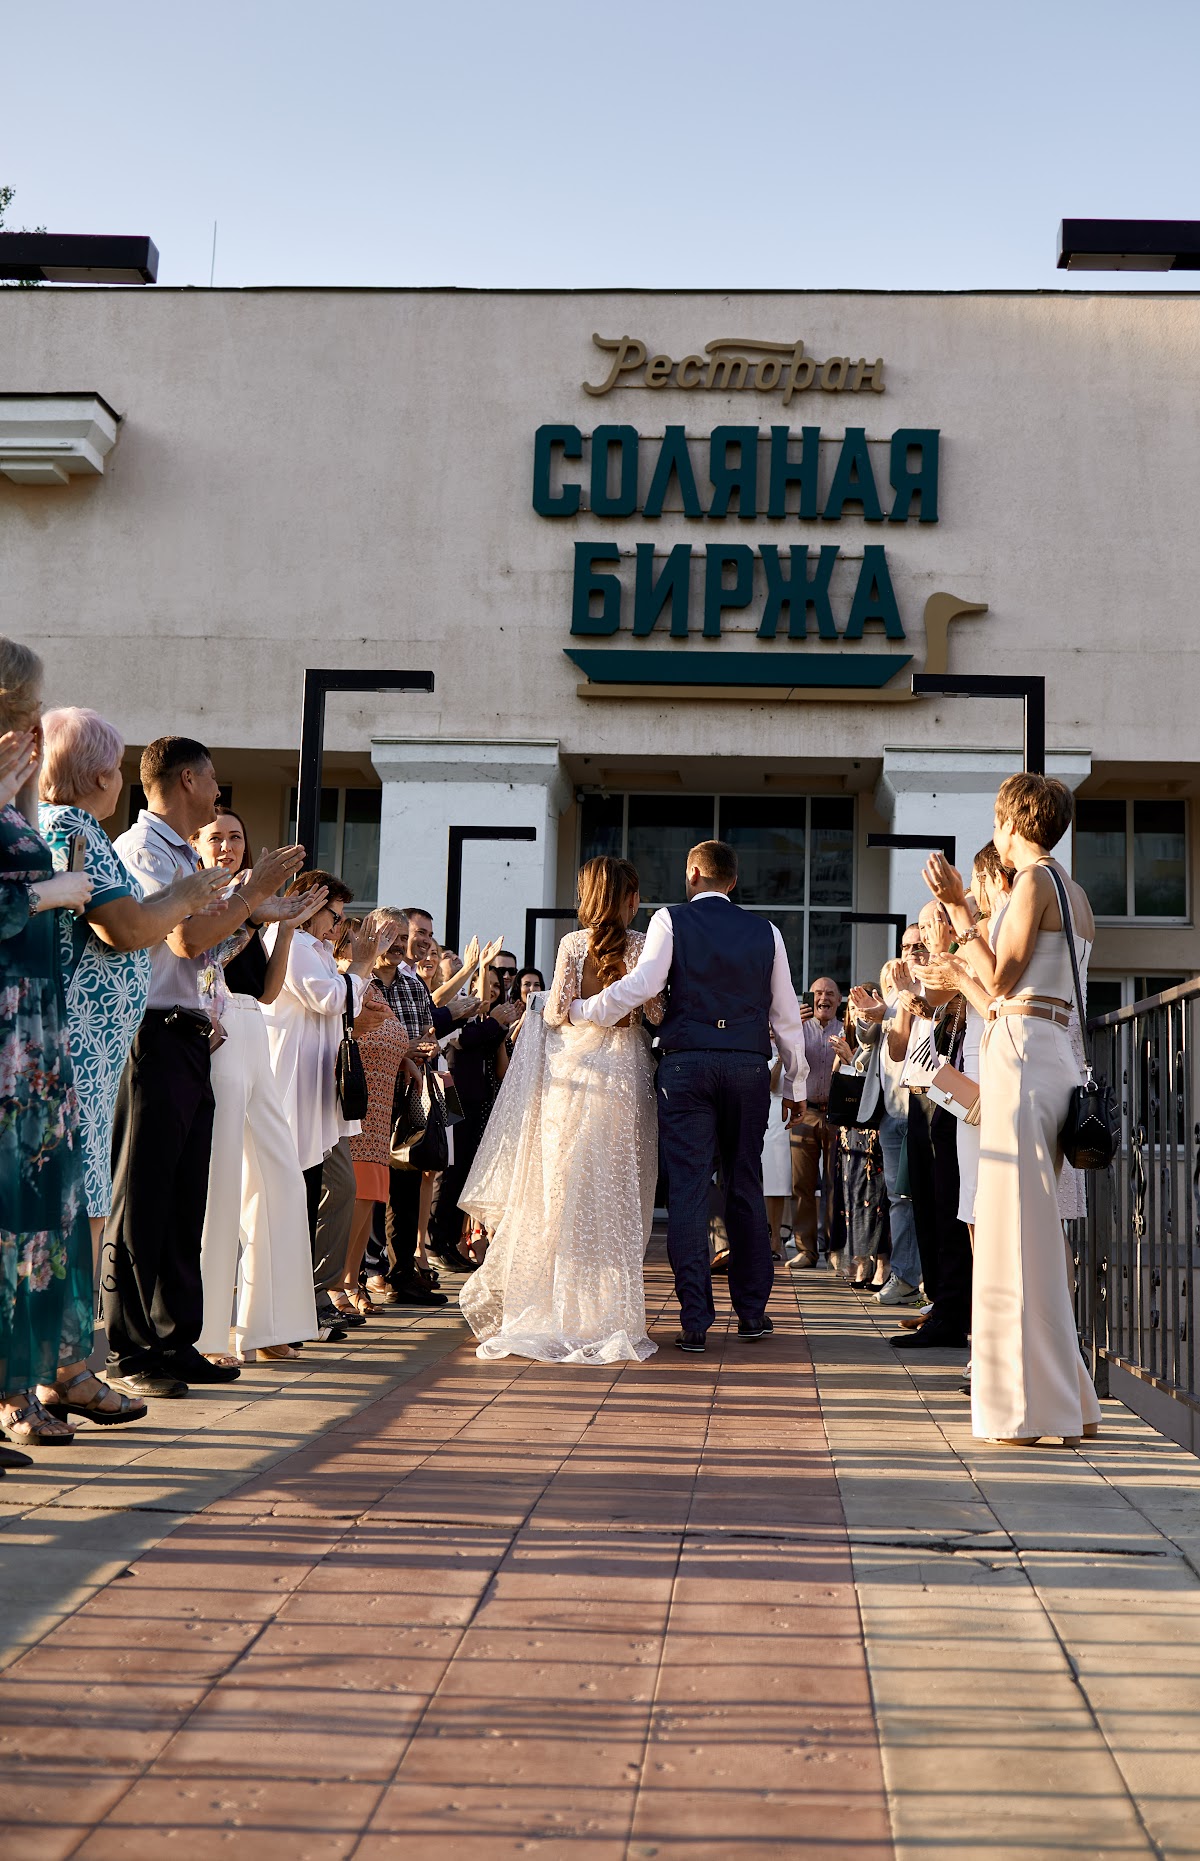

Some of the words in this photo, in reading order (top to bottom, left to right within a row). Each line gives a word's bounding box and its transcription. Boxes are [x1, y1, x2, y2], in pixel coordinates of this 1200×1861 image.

[582, 333, 886, 406] Ресторан
[532, 424, 941, 523] СОЛЯНАЯ
[570, 541, 906, 639] БИРЖА
